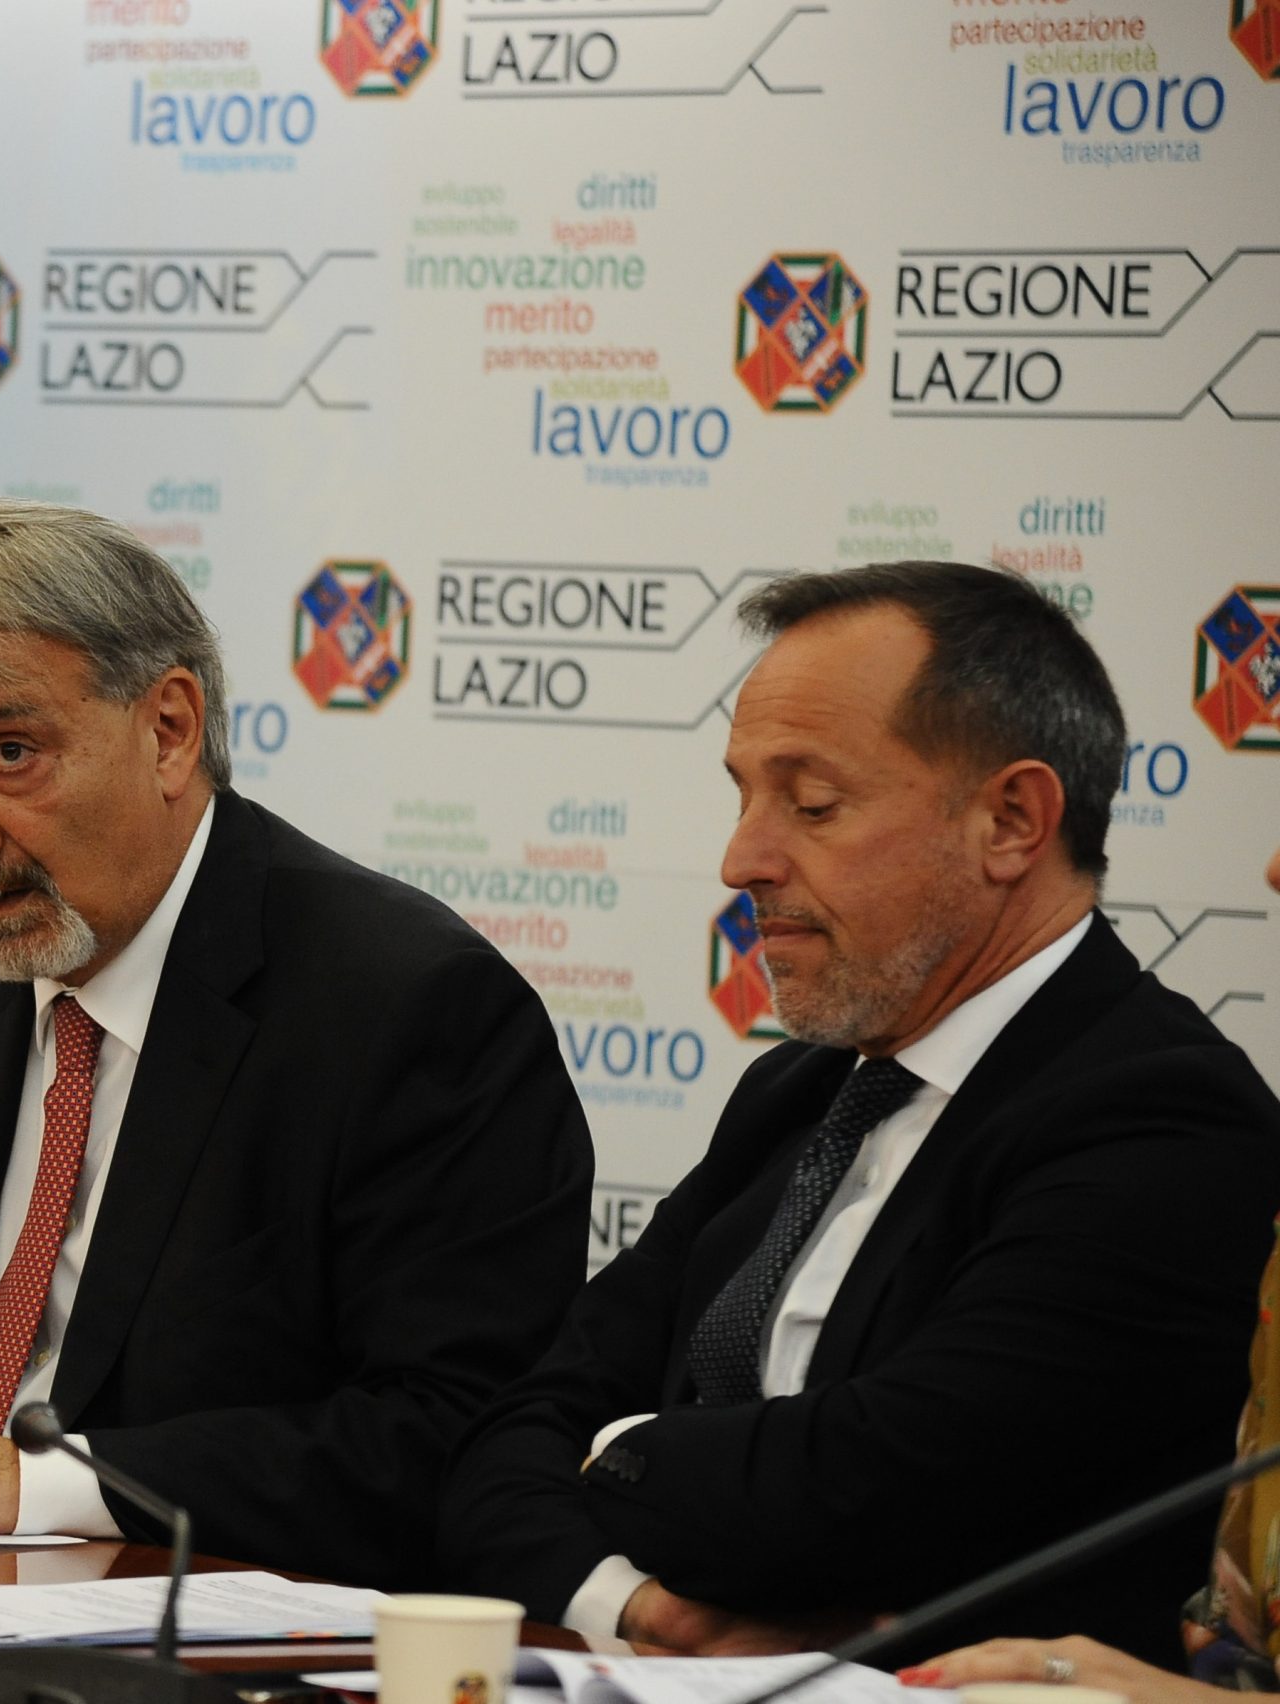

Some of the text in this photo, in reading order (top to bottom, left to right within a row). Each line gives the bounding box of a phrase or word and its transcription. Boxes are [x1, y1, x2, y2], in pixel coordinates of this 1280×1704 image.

[951, 12, 1146, 49] partecipazione
[463, 31, 618, 85] LAZIO
[1023, 46, 1160, 74] solidarietà
[131, 79, 317, 146] lavoro
[1004, 61, 1226, 135] lavoro
[1062, 138, 1202, 166] trasparenza
[577, 170, 657, 211] diritti
[552, 216, 637, 251] legalità
[44, 263, 255, 315] REGIONE
[405, 244, 647, 291] innovazione
[897, 264, 1152, 318] REGIONE
[485, 298, 594, 334] merito
[40, 341, 184, 393] LAZIO
[483, 344, 660, 375] partecipazione
[892, 350, 1063, 403] LAZIO
[532, 386, 731, 460] lavoro
[1019, 494, 1106, 536] diritti
[438, 573, 666, 632] REGIONE
[433, 656, 588, 711] LAZIO
[547, 796, 628, 839] diritti
[565, 1022, 706, 1083] voro
